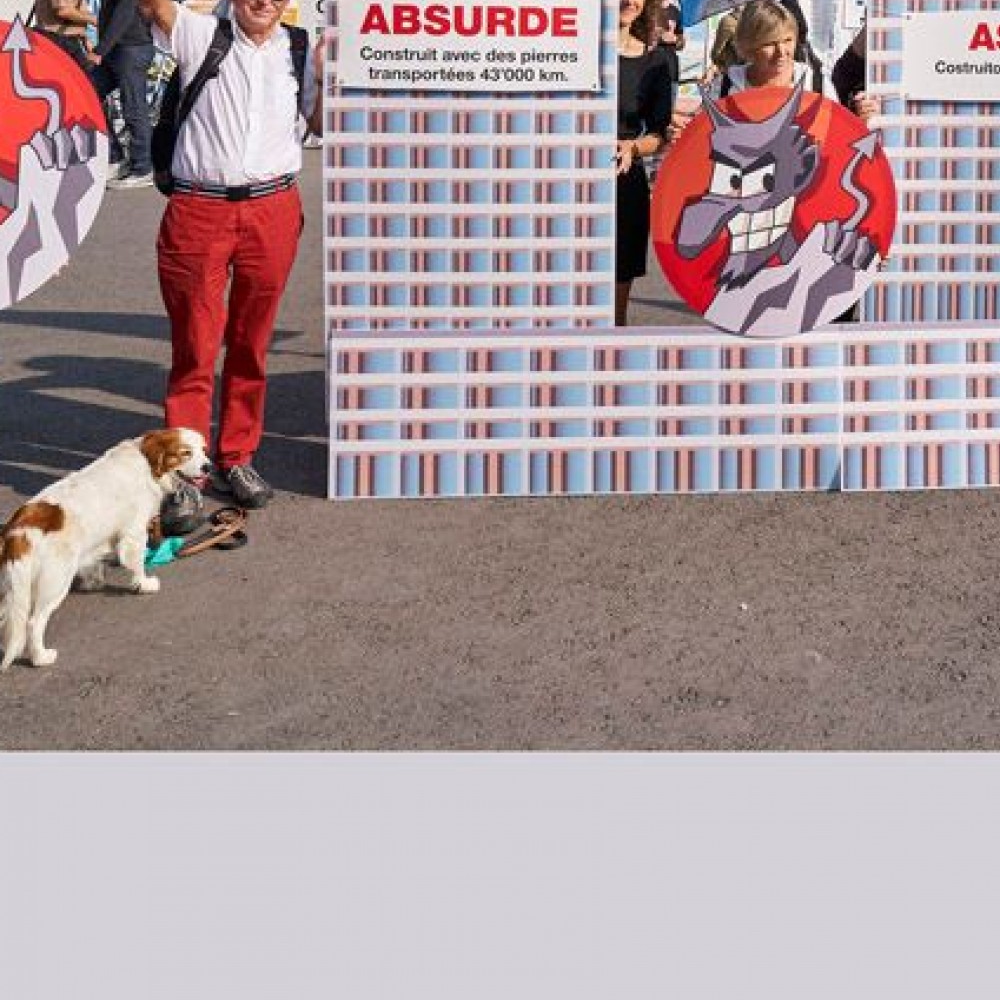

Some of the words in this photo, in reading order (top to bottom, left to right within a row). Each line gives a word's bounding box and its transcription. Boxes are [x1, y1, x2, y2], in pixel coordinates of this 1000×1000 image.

[360, 4, 578, 37] ABSURDE
[360, 46, 437, 61] Construit
[442, 49, 480, 63] avec
[485, 48, 516, 63] des
[520, 49, 579, 67] pierres
[369, 64, 475, 83] transportées
[479, 68, 535, 82] 43'000
[539, 68, 568, 82] km.
